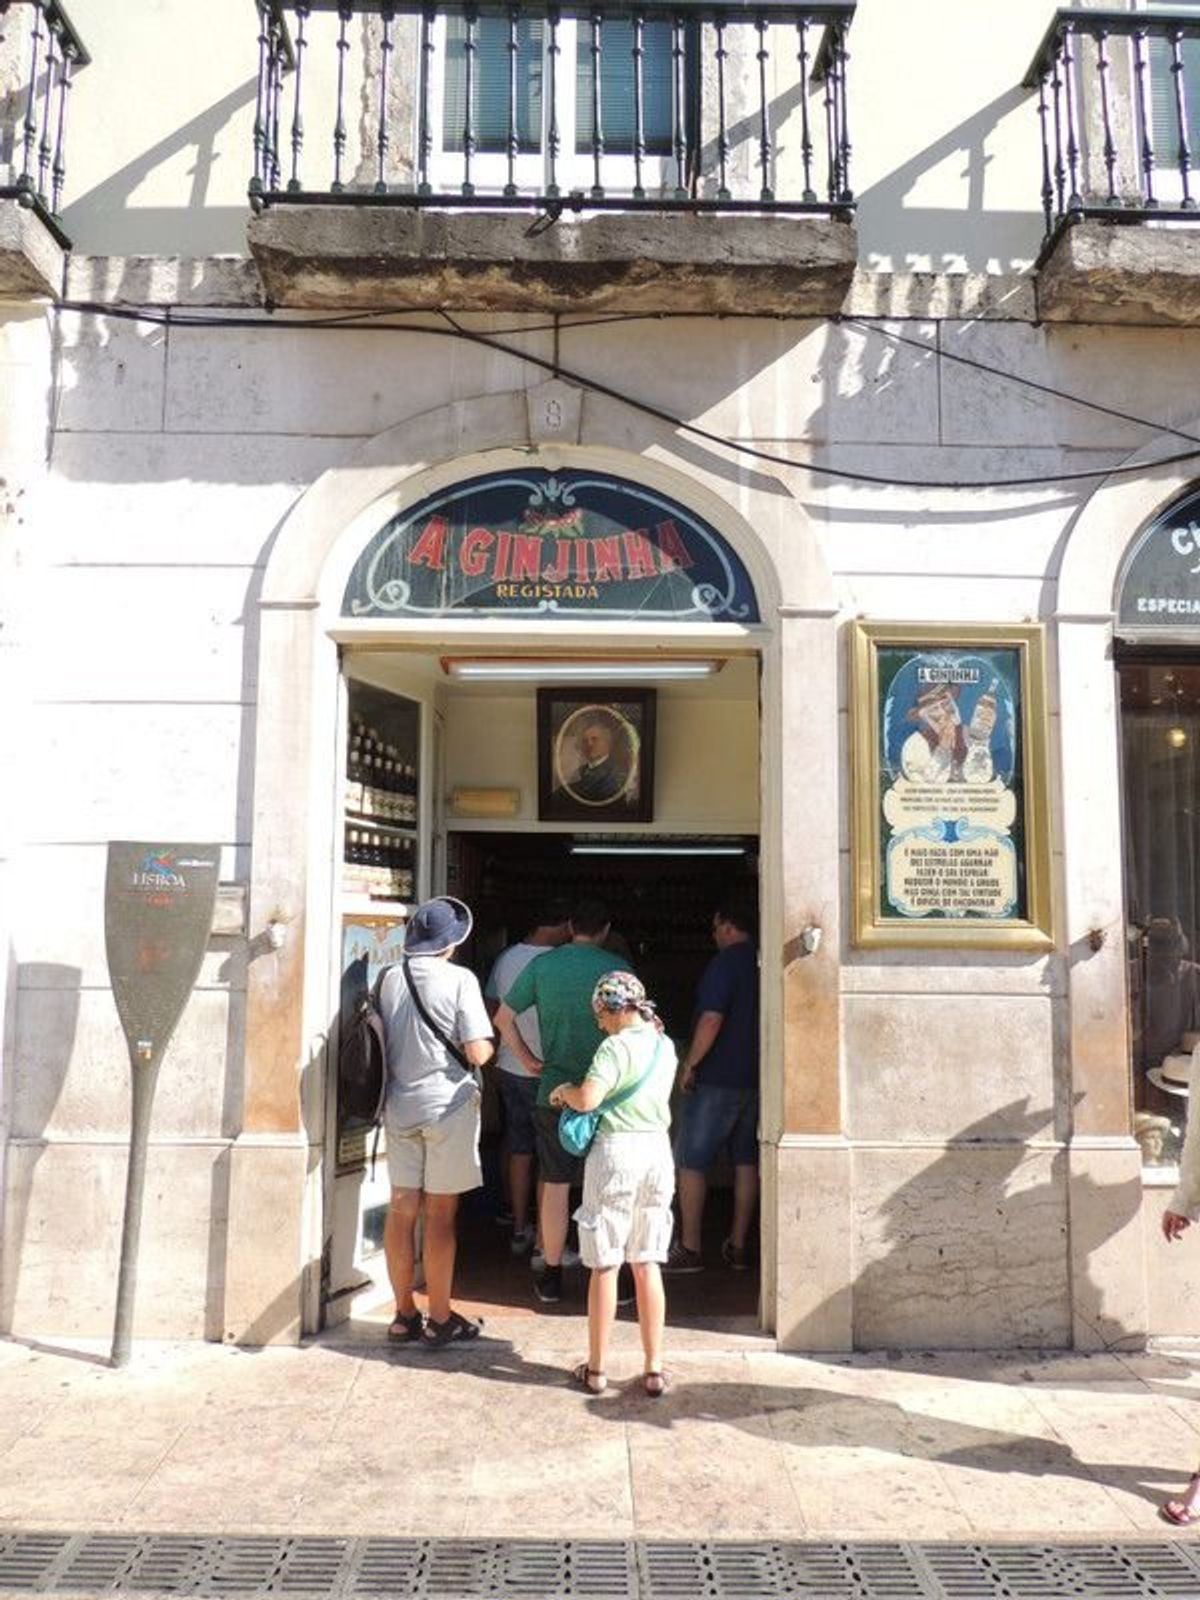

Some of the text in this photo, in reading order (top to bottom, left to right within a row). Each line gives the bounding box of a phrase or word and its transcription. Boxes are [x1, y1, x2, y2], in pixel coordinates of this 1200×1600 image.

[408, 517, 695, 584] A GINJINHA
[496, 583, 599, 600] REGISTADA
